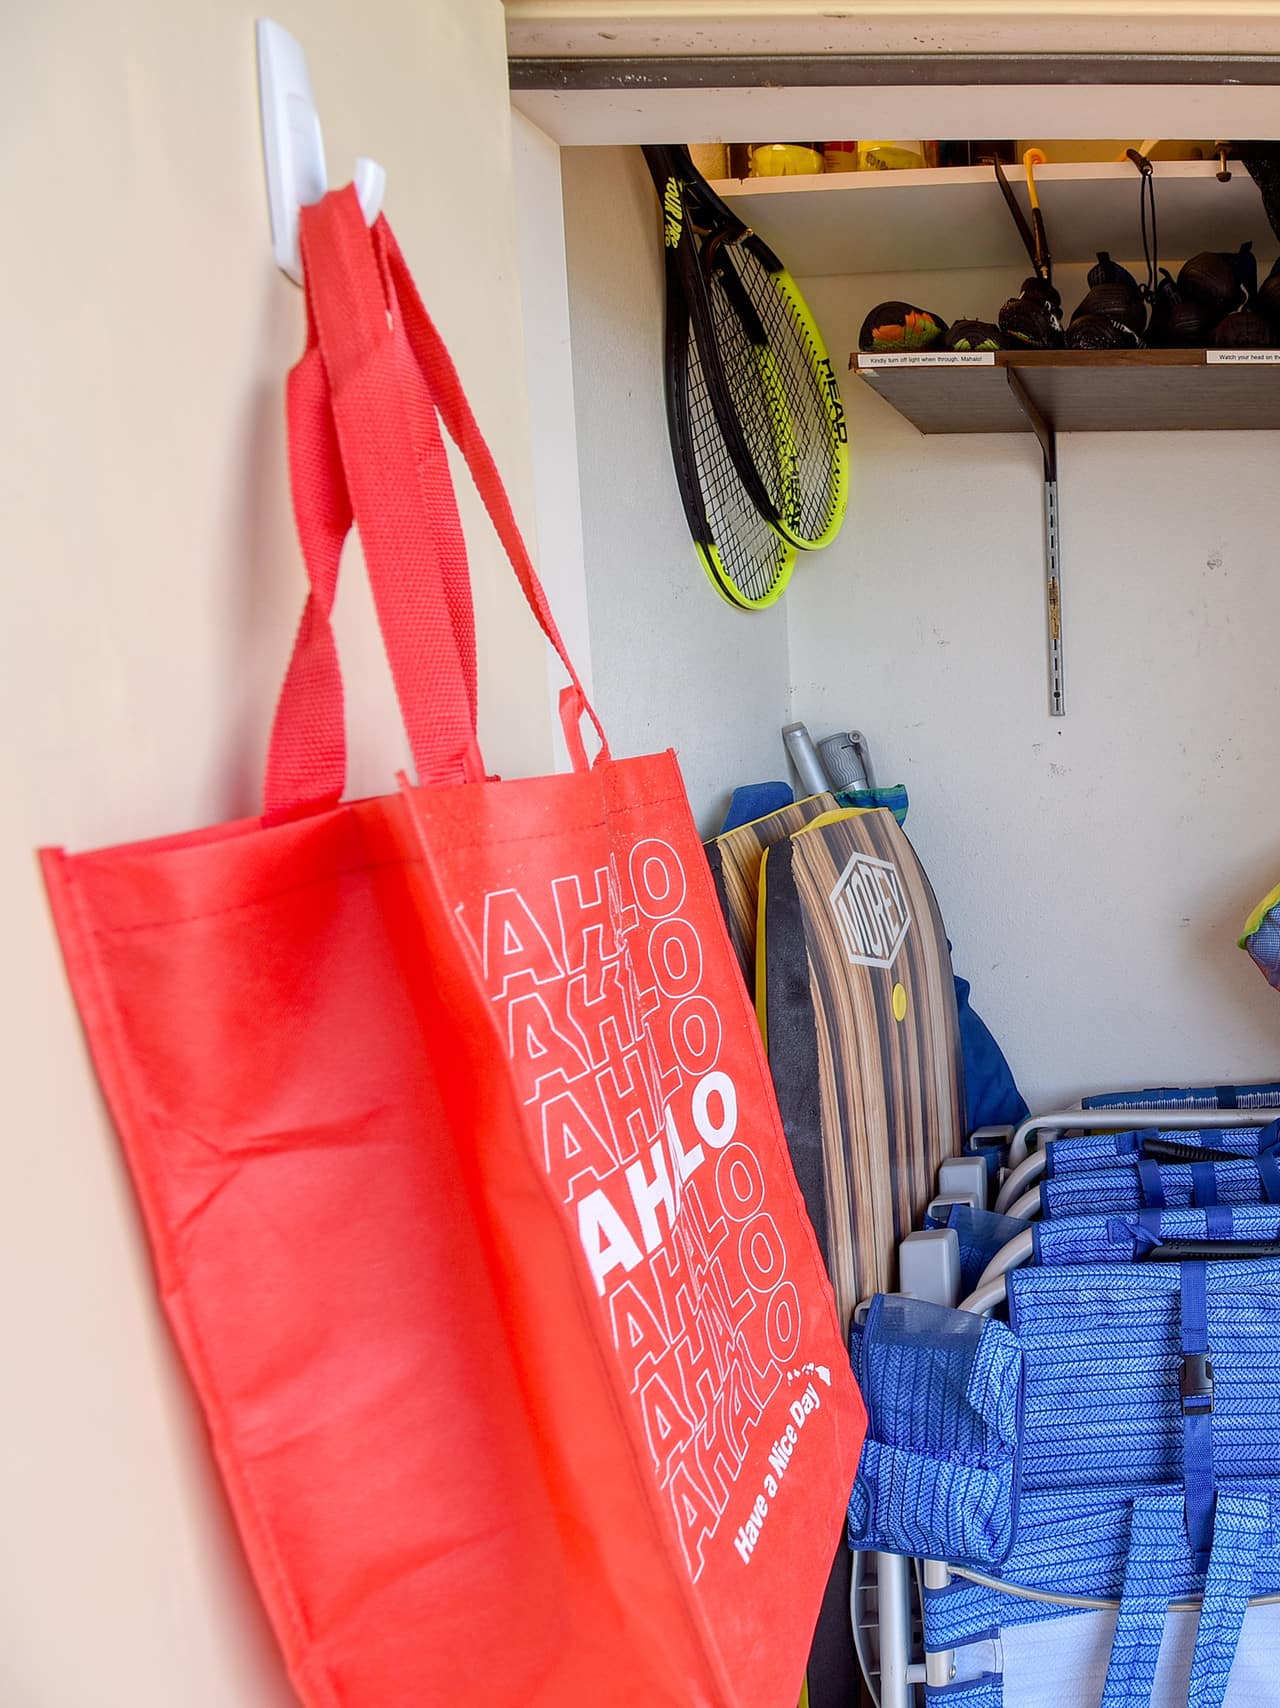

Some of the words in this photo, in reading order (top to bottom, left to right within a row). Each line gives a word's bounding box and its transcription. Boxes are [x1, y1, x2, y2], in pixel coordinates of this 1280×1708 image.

[821, 358, 848, 444] HEAD
[838, 862, 905, 960] MOREY
[789, 1382, 821, 1429] Day
[768, 1424, 798, 1479] Nice
[764, 1473, 779, 1498] a
[733, 1494, 769, 1565] Have
